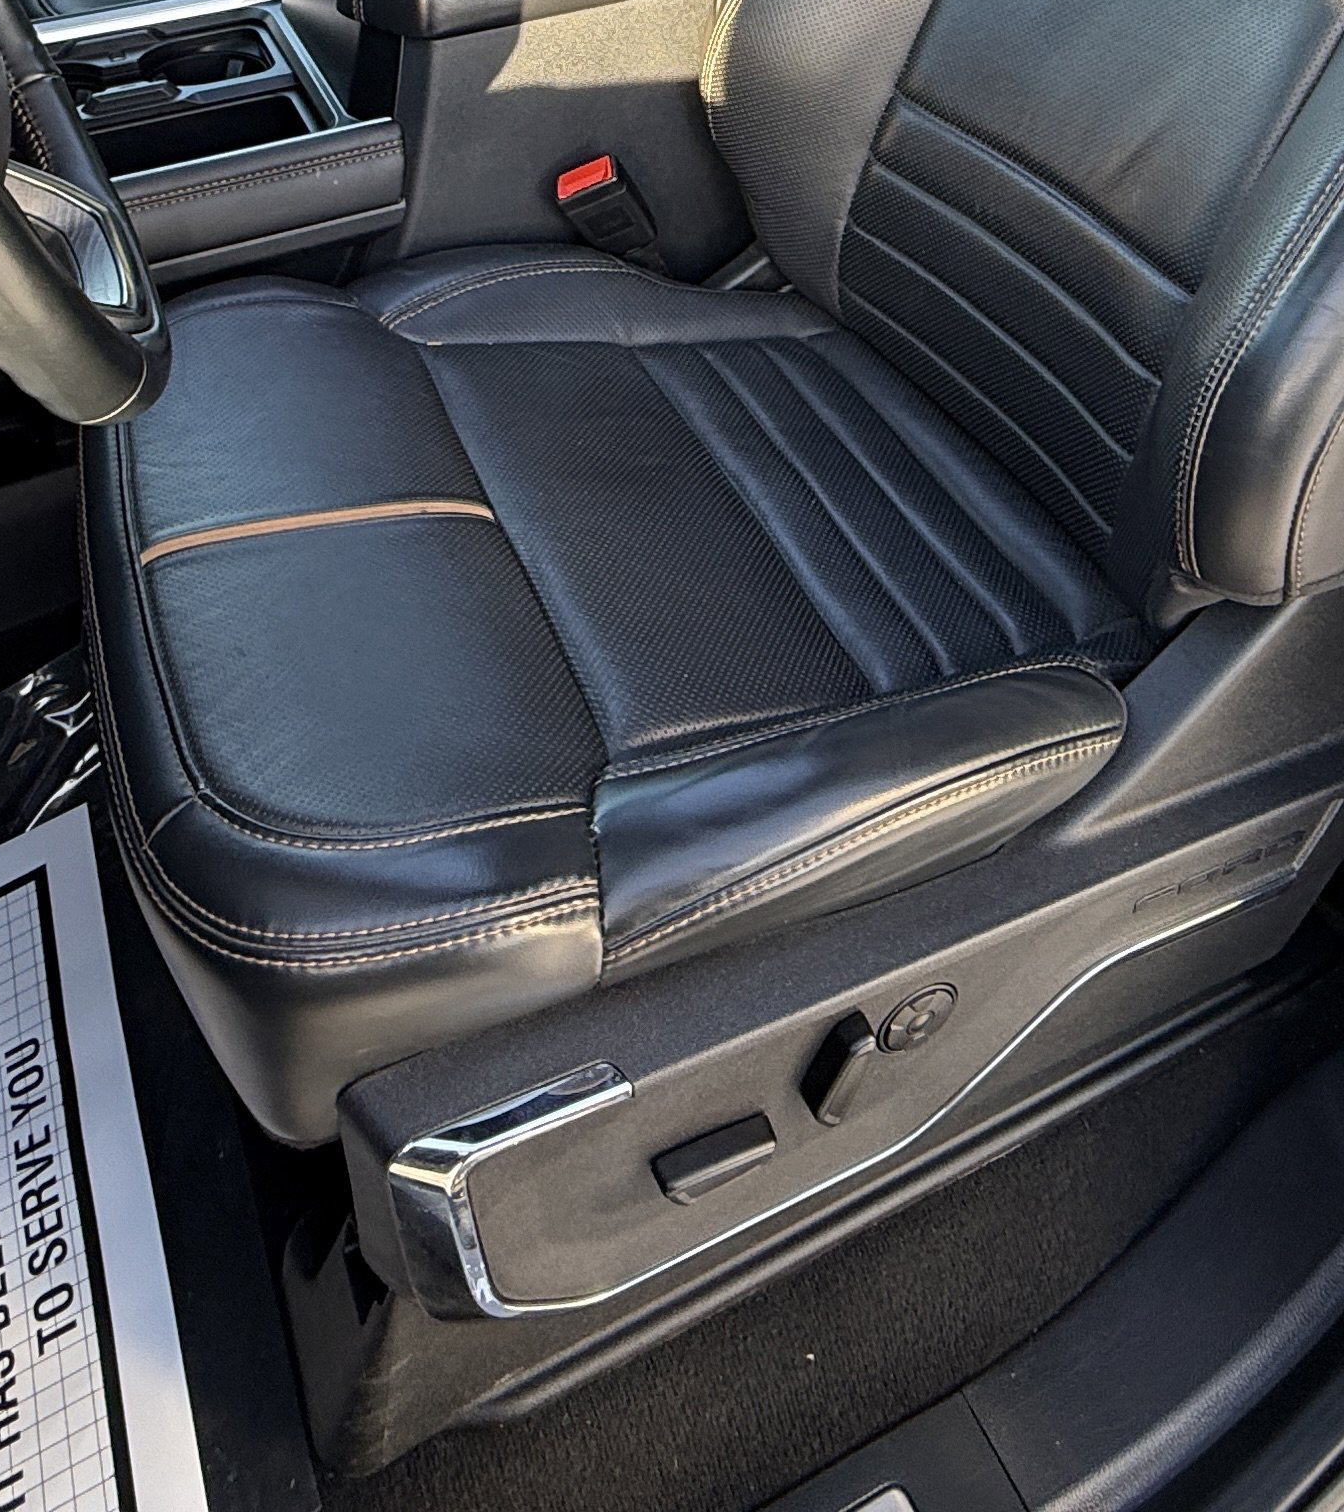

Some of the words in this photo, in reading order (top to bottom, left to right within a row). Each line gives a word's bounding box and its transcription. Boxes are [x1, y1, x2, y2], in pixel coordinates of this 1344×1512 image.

[4, 1037, 47, 1128] YOU
[14, 1124, 68, 1277] SERVE
[34, 1282, 77, 1357] TO
